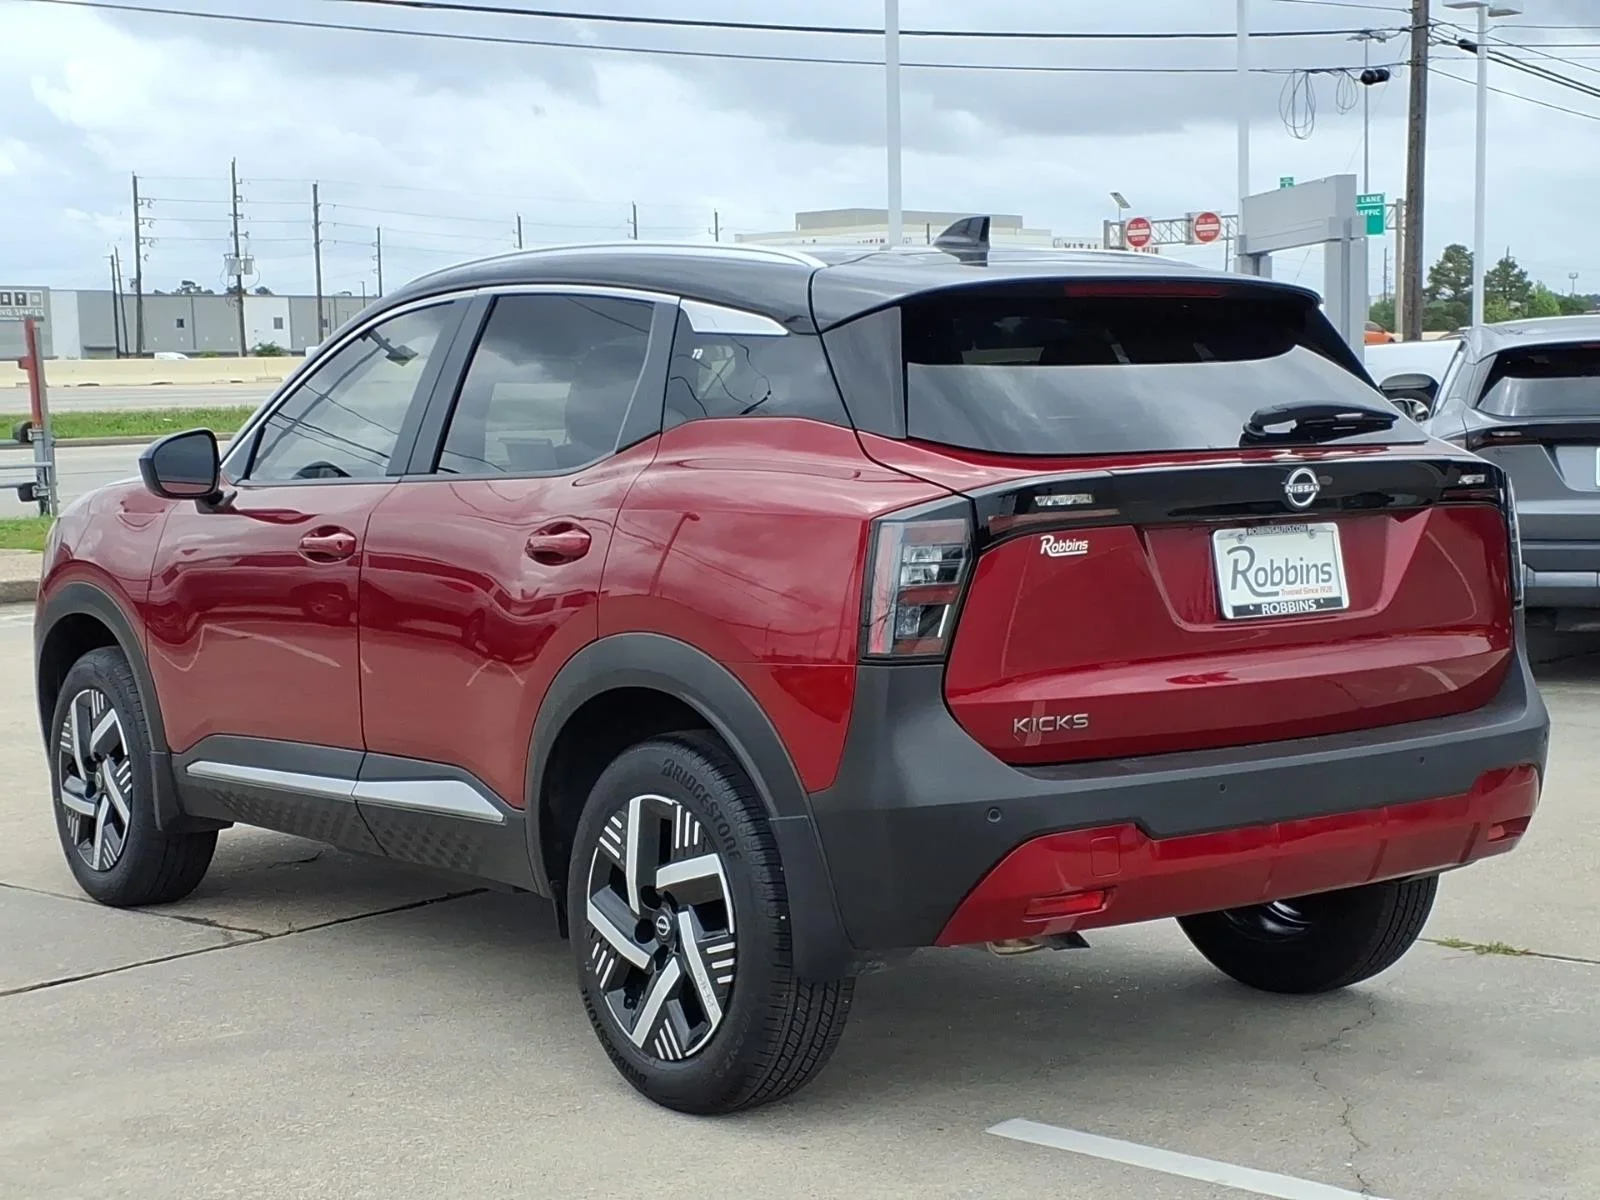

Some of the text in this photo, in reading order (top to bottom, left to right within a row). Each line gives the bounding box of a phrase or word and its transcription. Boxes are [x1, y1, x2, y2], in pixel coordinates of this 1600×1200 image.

[1285, 484, 1320, 494] NISSAN
[1040, 534, 1089, 557] Robbins
[1226, 545, 1333, 597] Robbins
[1261, 599, 1317, 615] ROBBINS
[1013, 713, 1089, 735] KICKS
[660, 758, 742, 861] BRIDGESTONE
